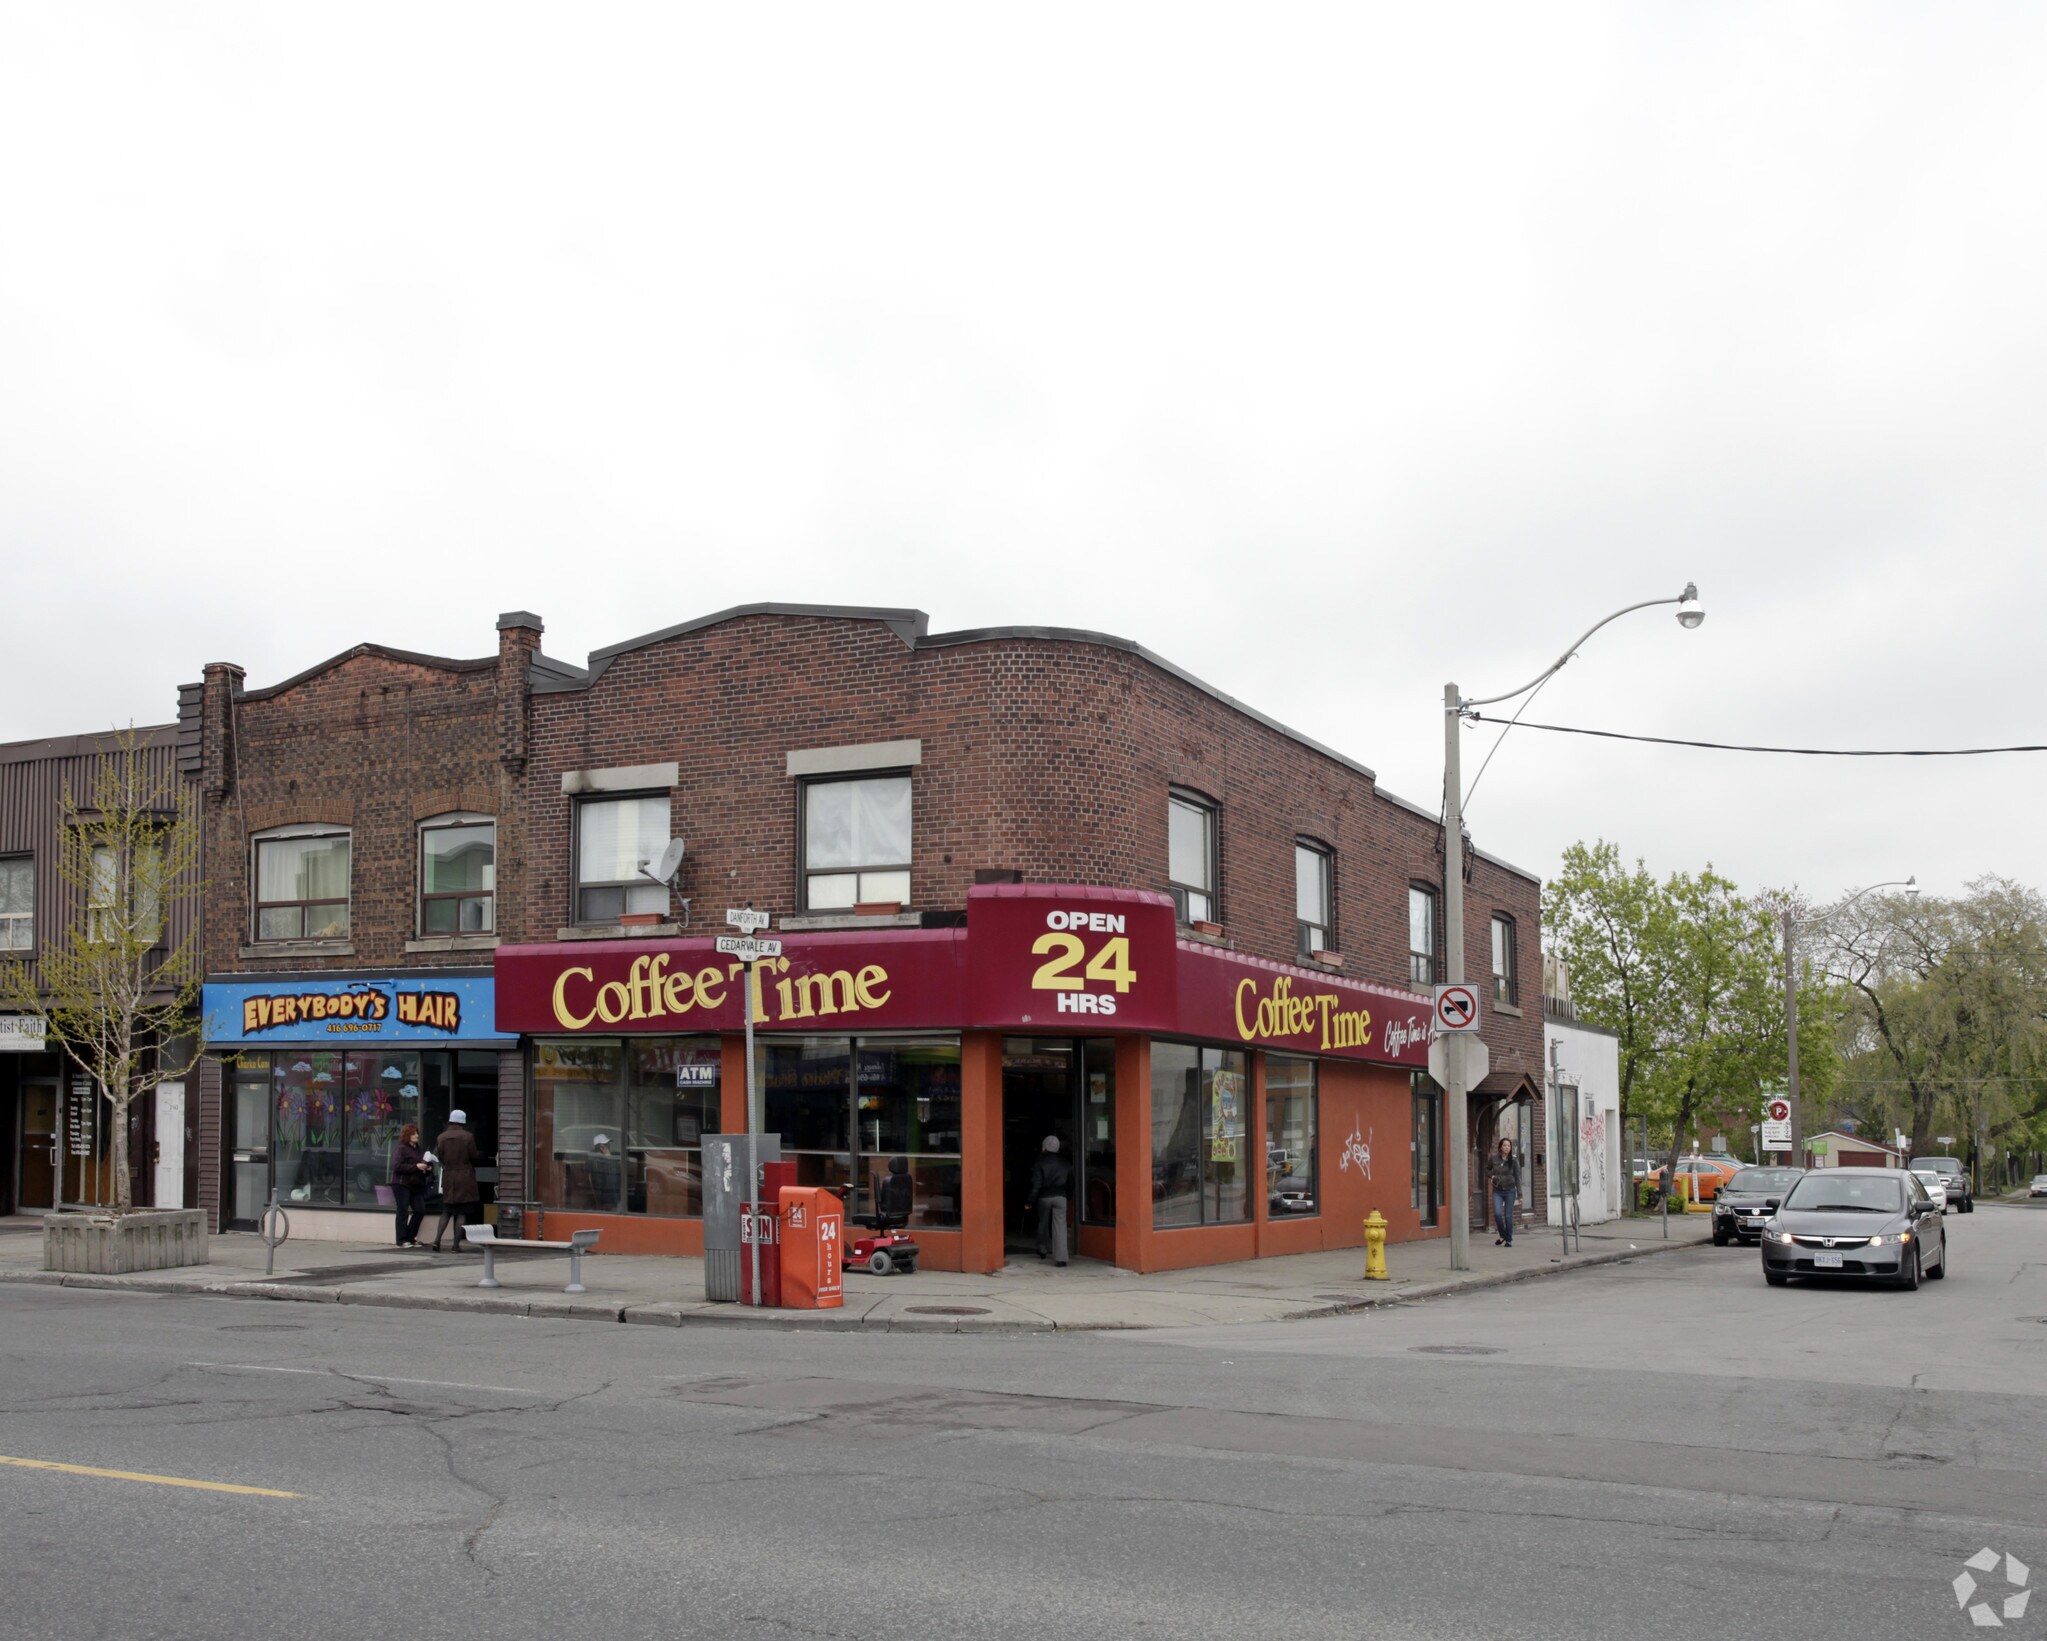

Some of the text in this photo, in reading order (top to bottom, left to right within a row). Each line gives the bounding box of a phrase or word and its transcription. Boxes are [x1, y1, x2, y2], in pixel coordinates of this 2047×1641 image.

[730, 911, 757, 925] DANFORTH
[1046, 910, 1126, 934] OPEN
[720, 939, 765, 952] CEDARVALE
[1031, 933, 1137, 994] 24
[552, 953, 892, 1030] Coffee Time
[243, 991, 459, 1032] EVERYBODY'S HAIR
[1057, 992, 1117, 1016] HRS
[1235, 975, 1314, 1041] Coffee
[1314, 993, 1372, 1051] Time
[19, 1019, 42, 1034] Faith
[326, 1022, 382, 1033] 416 696-0717
[1384, 1020, 1407, 1058] Coffee
[680, 1067, 713, 1080] ATM
[792, 1207, 802, 1220] 24
[821, 1221, 836, 1241] 24
